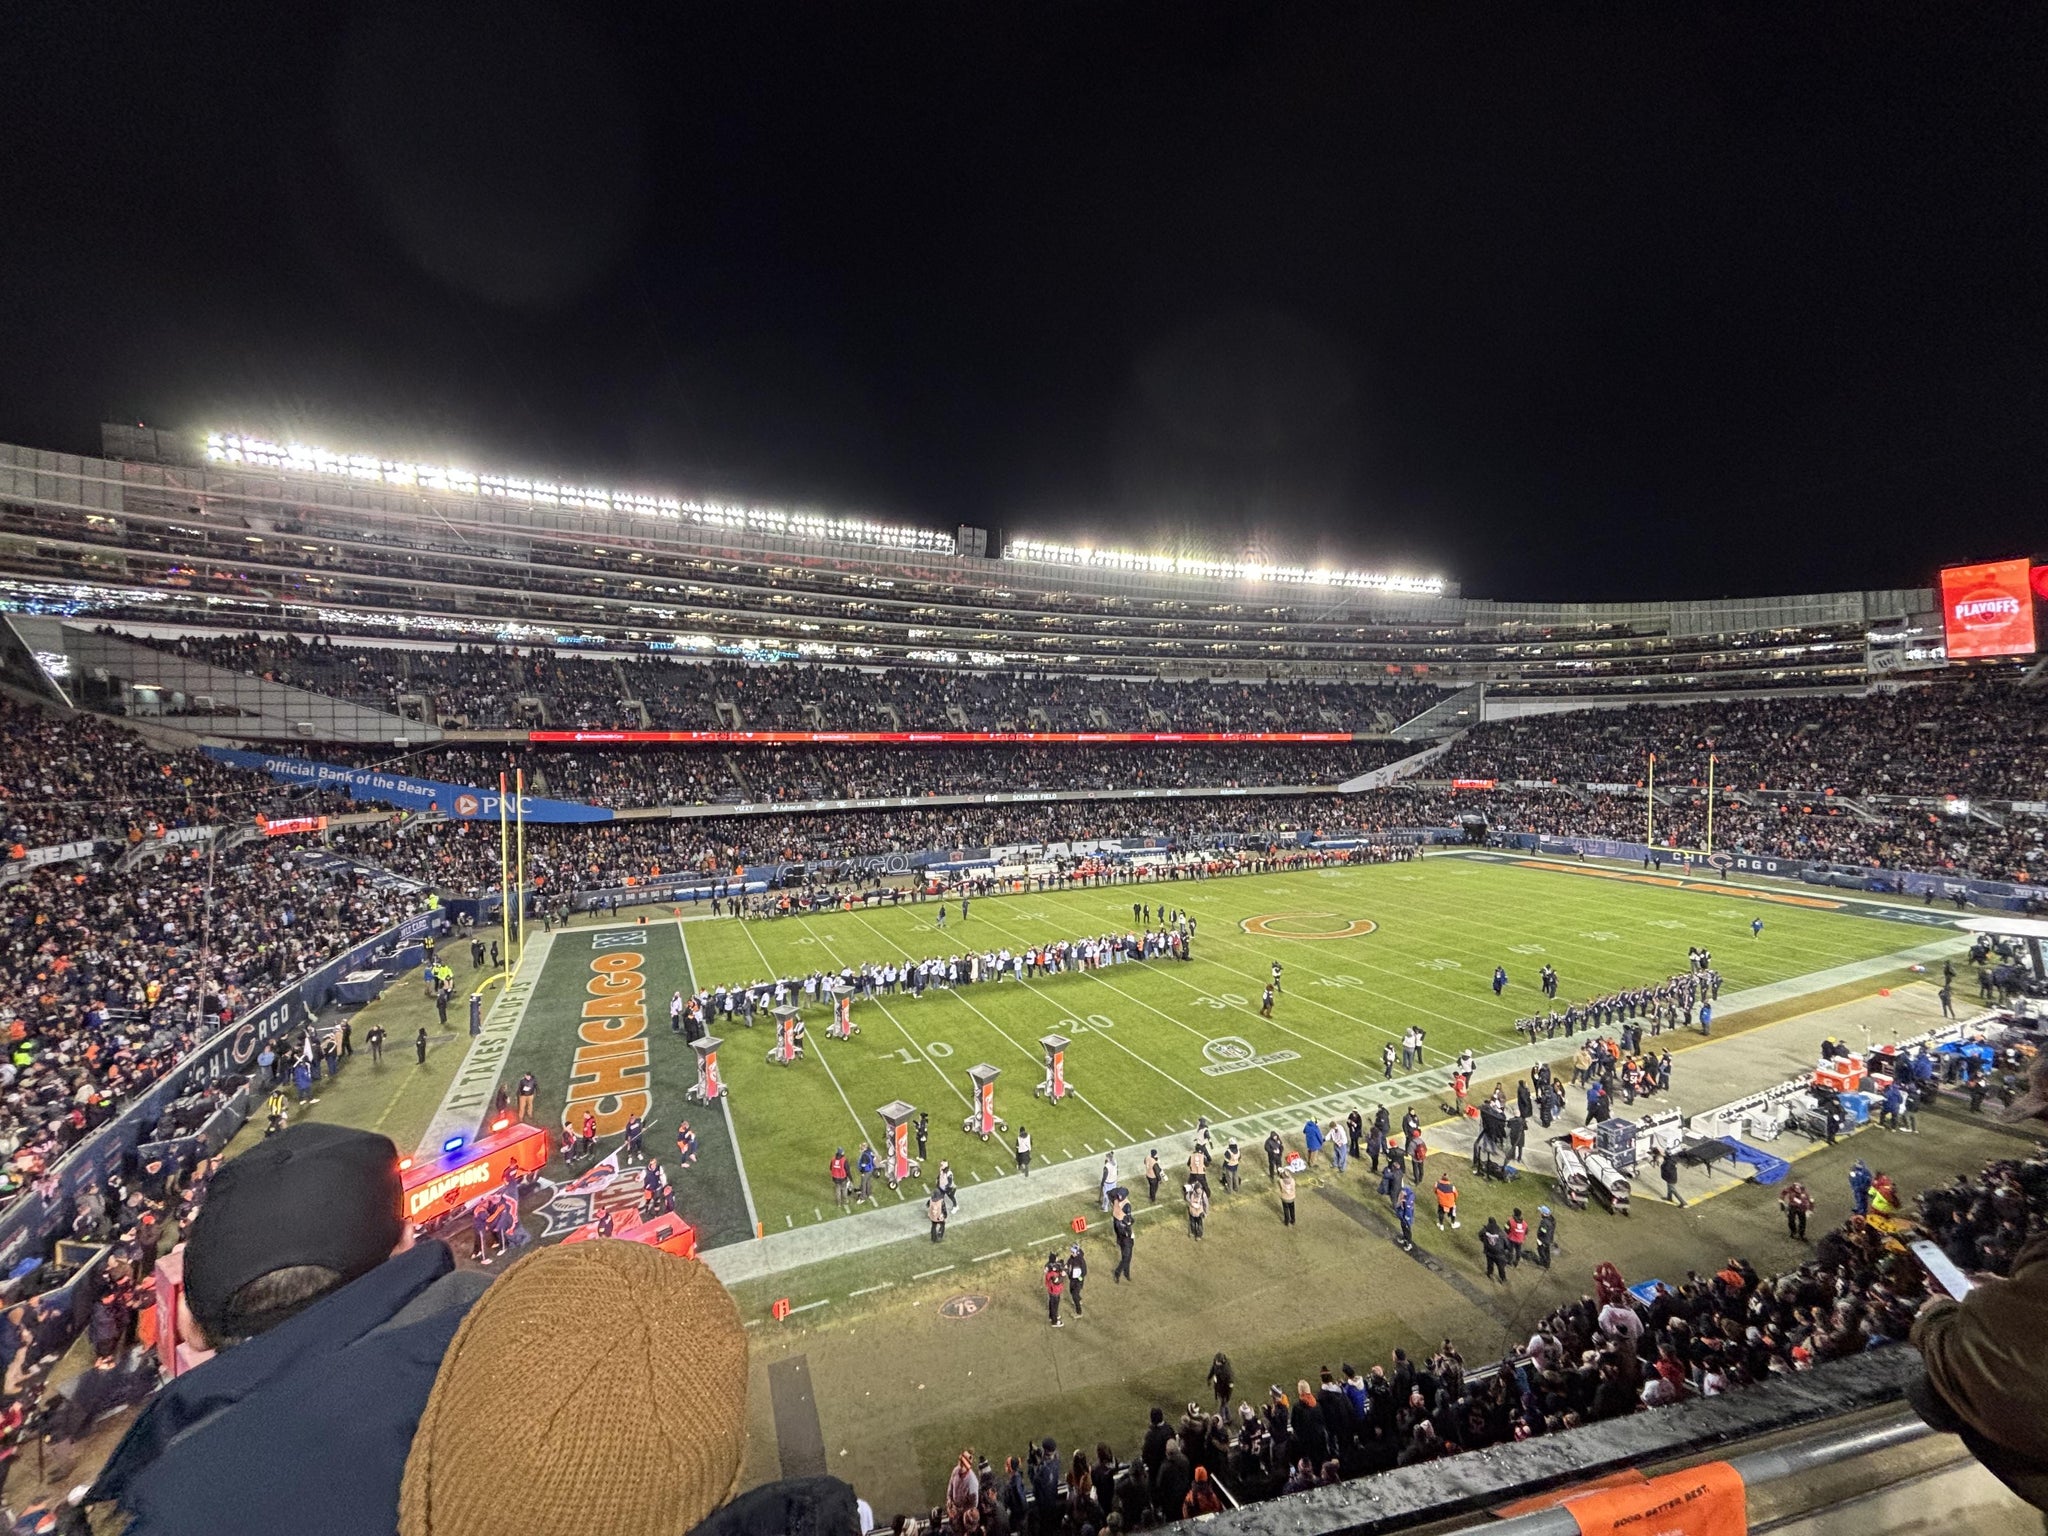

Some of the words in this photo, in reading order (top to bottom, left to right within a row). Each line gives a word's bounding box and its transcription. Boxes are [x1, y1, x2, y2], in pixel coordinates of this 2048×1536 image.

[1955, 599, 2020, 620] PLAYOFFS
[266, 759, 316, 777] Official
[319, 765, 354, 784] Bank
[356, 774, 370, 786] of
[372, 776, 395, 790] the
[398, 779, 437, 798] Bears
[1587, 782, 1629, 792] DOWN
[481, 796, 533, 814] PNC
[1012, 793, 1038, 801] SOLDIER
[164, 825, 213, 844] OWN
[27, 842, 95, 868] BEAR
[1672, 851, 1777, 873] CHICAGO
[1319, 974, 1364, 988] 40
[498, 996, 525, 1009] OF
[1198, 993, 1249, 1009] 30
[485, 1012, 519, 1032] ALL
[1059, 1013, 1114, 1034] 20
[195, 1003, 290, 1085] CHICAGO
[561, 952, 653, 1138] CHICAGO
[894, 1041, 954, 1065] 10
[459, 1037, 509, 1086] TAKES
[1209, 1060, 1249, 1074] WILD
[1250, 1051, 1292, 1067] CARD
[446, 1092, 486, 1111] IT
[1211, 1093, 1375, 1149] AMERICA
[1377, 1074, 1450, 1099] 250
[410, 1162, 490, 1214] CHAMPIONS
[1074, 1217, 1086, 1232] 10
[952, 1300, 976, 1316] 76
[1613, 1513, 1642, 1529] GOOD
[1645, 1497, 1682, 1518] BETTER
